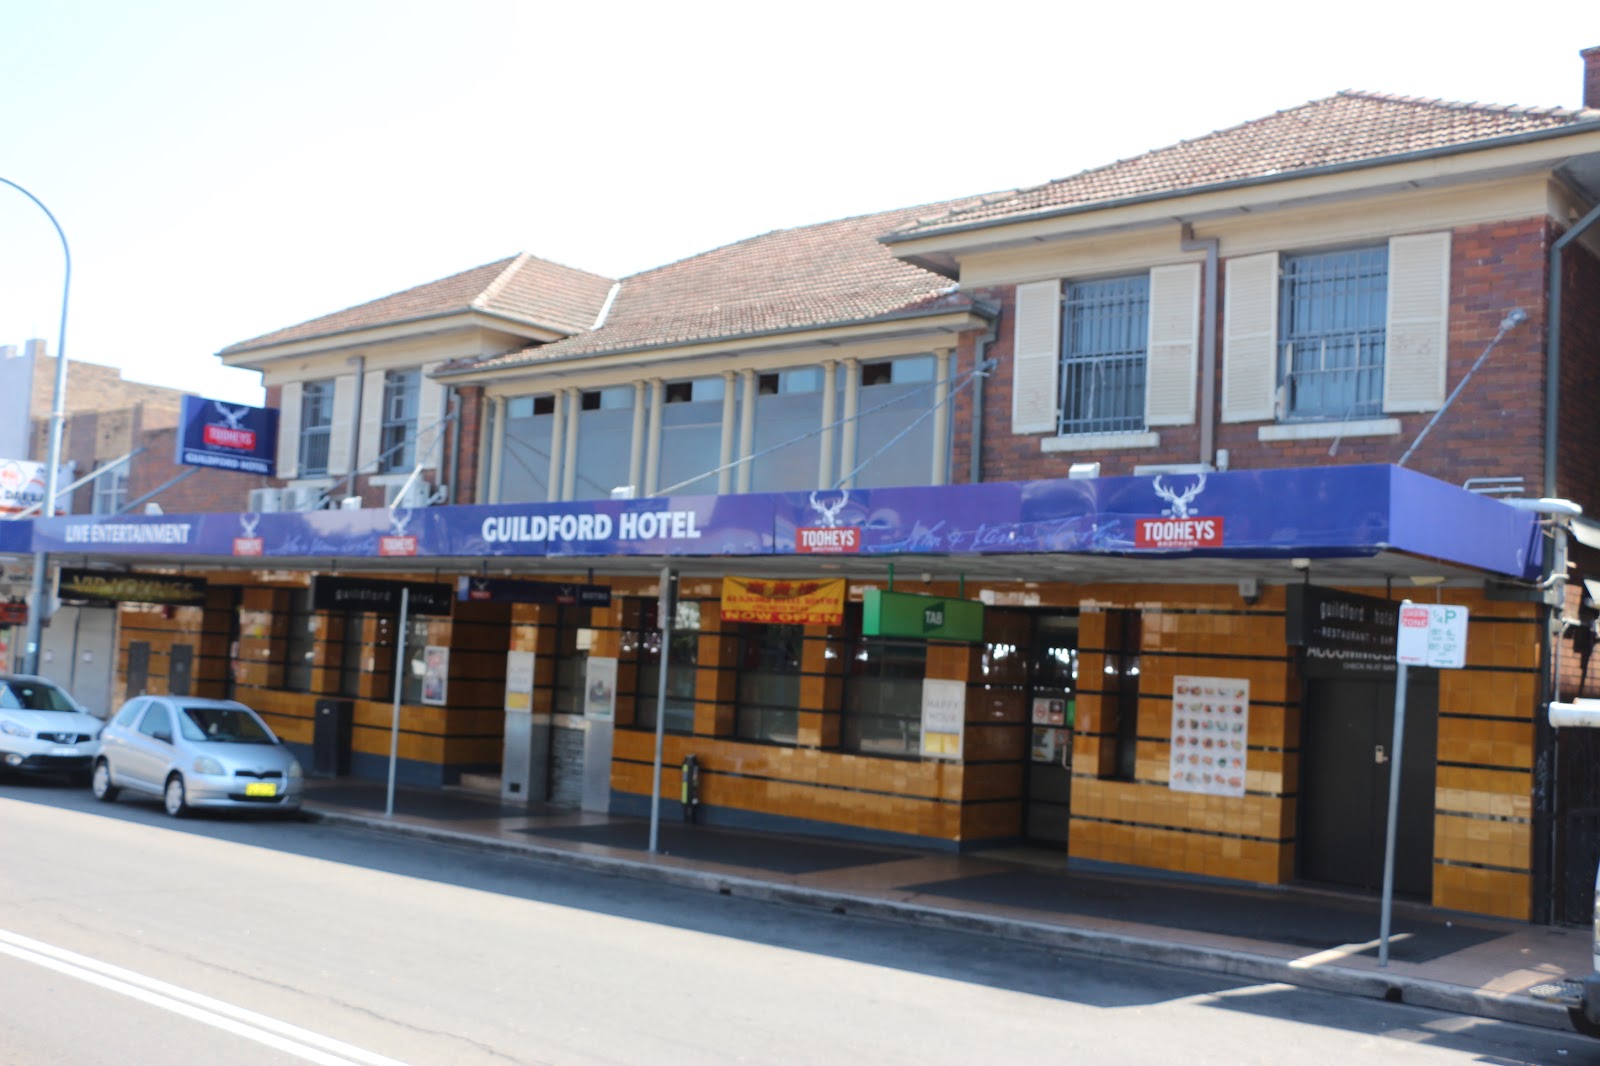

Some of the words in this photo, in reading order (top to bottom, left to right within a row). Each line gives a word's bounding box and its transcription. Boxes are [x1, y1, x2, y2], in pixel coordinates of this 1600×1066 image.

[64, 524, 90, 543] LIVE
[90, 523, 192, 545] ENTERTAINMENT
[481, 513, 613, 543] GUILDFORD
[618, 510, 702, 540] HOTEL
[1143, 520, 1215, 541] TOOHEYS
[801, 529, 856, 547] TOOHEYS
[725, 609, 771, 620] NOW
[778, 612, 839, 623] OPEN
[924, 610, 943, 625] TAB
[1320, 601, 1364, 622] guildford
